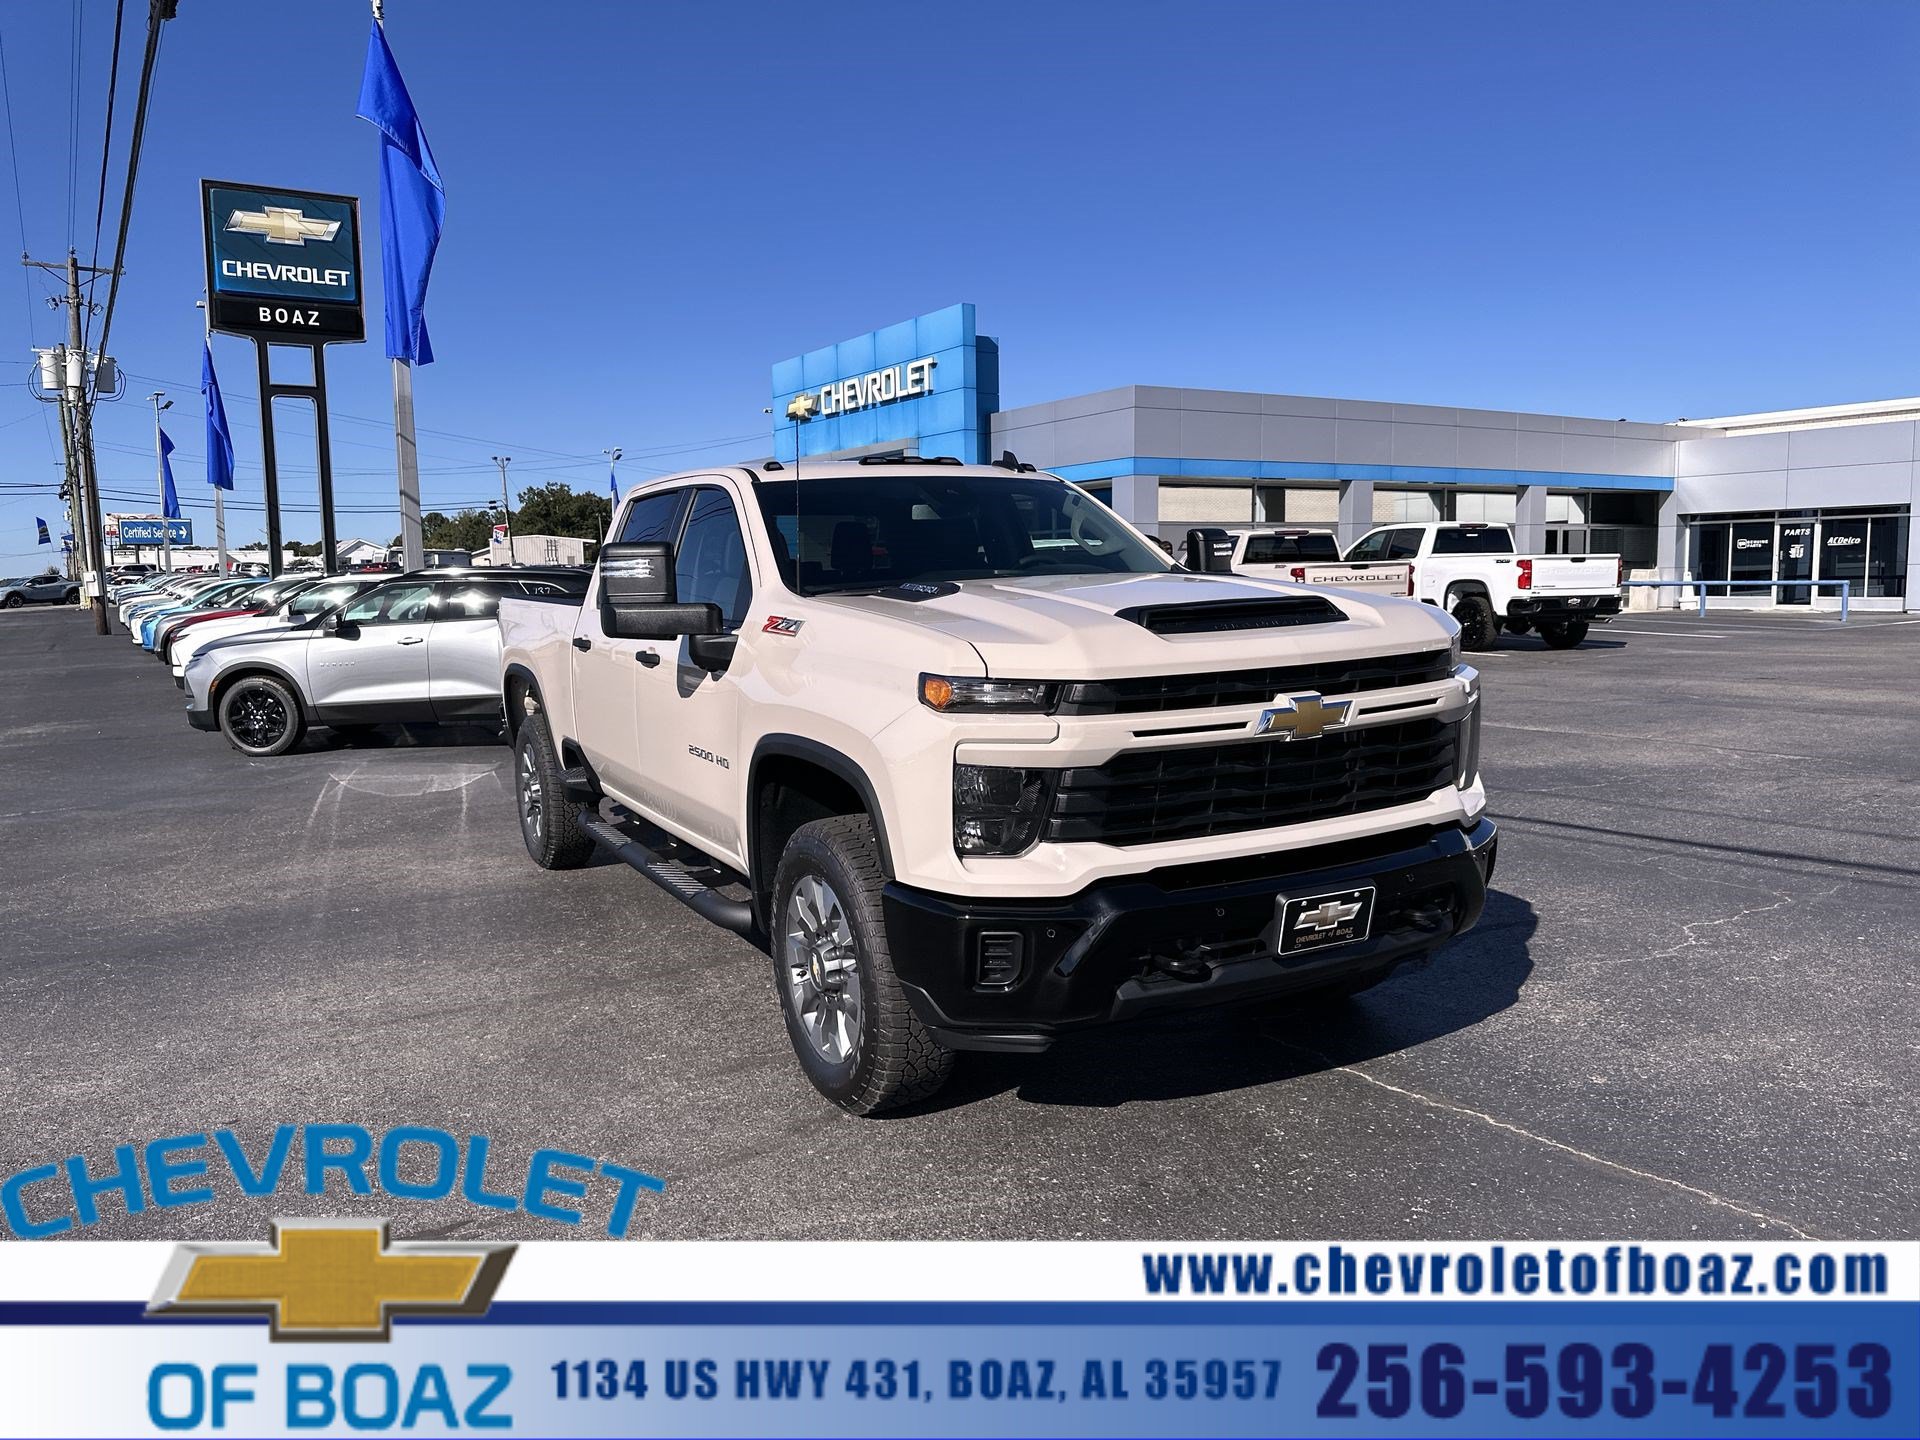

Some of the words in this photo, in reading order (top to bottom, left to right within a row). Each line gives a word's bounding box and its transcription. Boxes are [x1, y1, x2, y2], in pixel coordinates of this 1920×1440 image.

[222, 259, 350, 286] CHEVROLET
[258, 307, 320, 326] BOAZ
[820, 356, 935, 415] CHEVROLET
[123, 526, 152, 539] Certified
[153, 527, 176, 539] Serce
[1784, 528, 1811, 536] PARTS
[1827, 536, 1862, 546] ACDelco
[1313, 573, 1403, 583] CHEVROLET
[762, 615, 806, 638] Z71
[688, 744, 715, 763] 2500
[716, 755, 730, 770] HD
[1295, 932, 1326, 944] CHEVROLET
